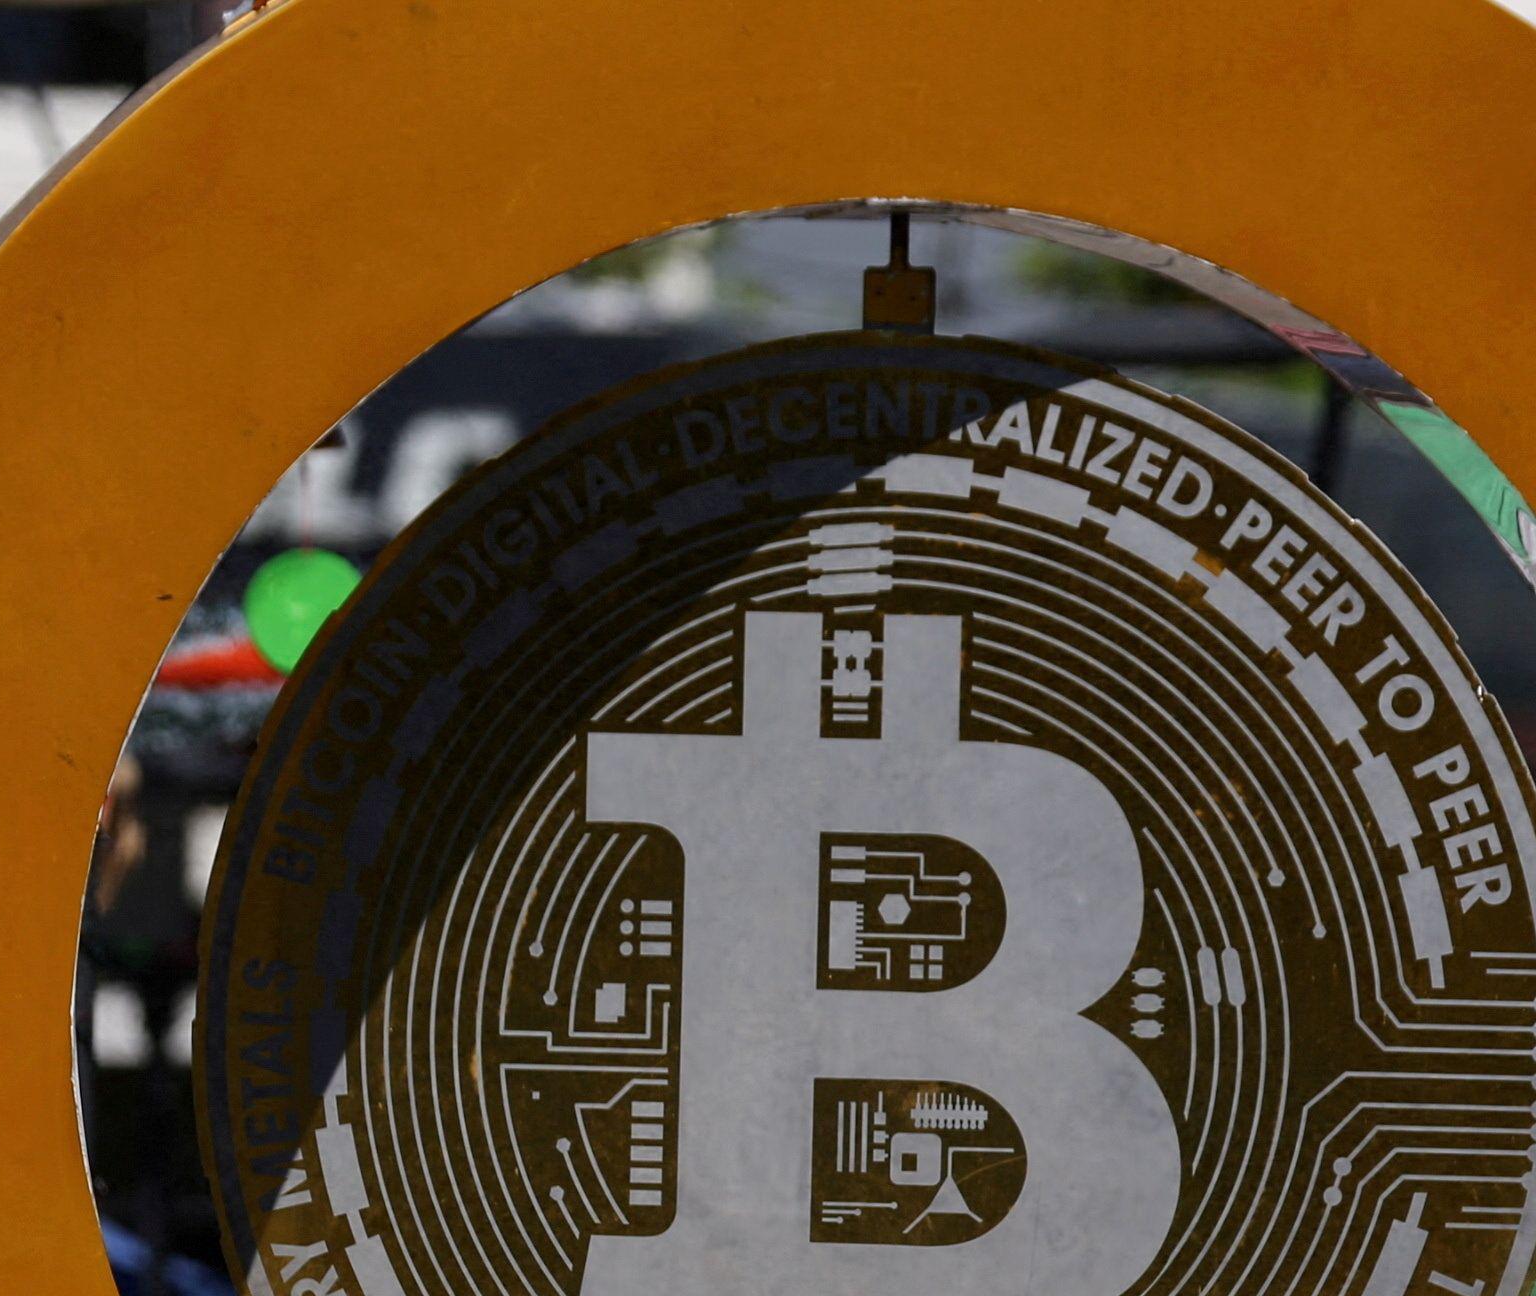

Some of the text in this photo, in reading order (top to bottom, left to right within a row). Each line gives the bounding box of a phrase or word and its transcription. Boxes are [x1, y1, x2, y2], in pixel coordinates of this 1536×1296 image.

[265, 618, 432, 883] BITCOIN
[418, 440, 661, 625] DIGITAL
[673, 379, 1214, 520] DECENTRALIZED
[1220, 506, 1366, 646] PEER
[1354, 637, 1434, 732] TO
[1413, 744, 1512, 914] PEER
[239, 957, 312, 1211] METALS
